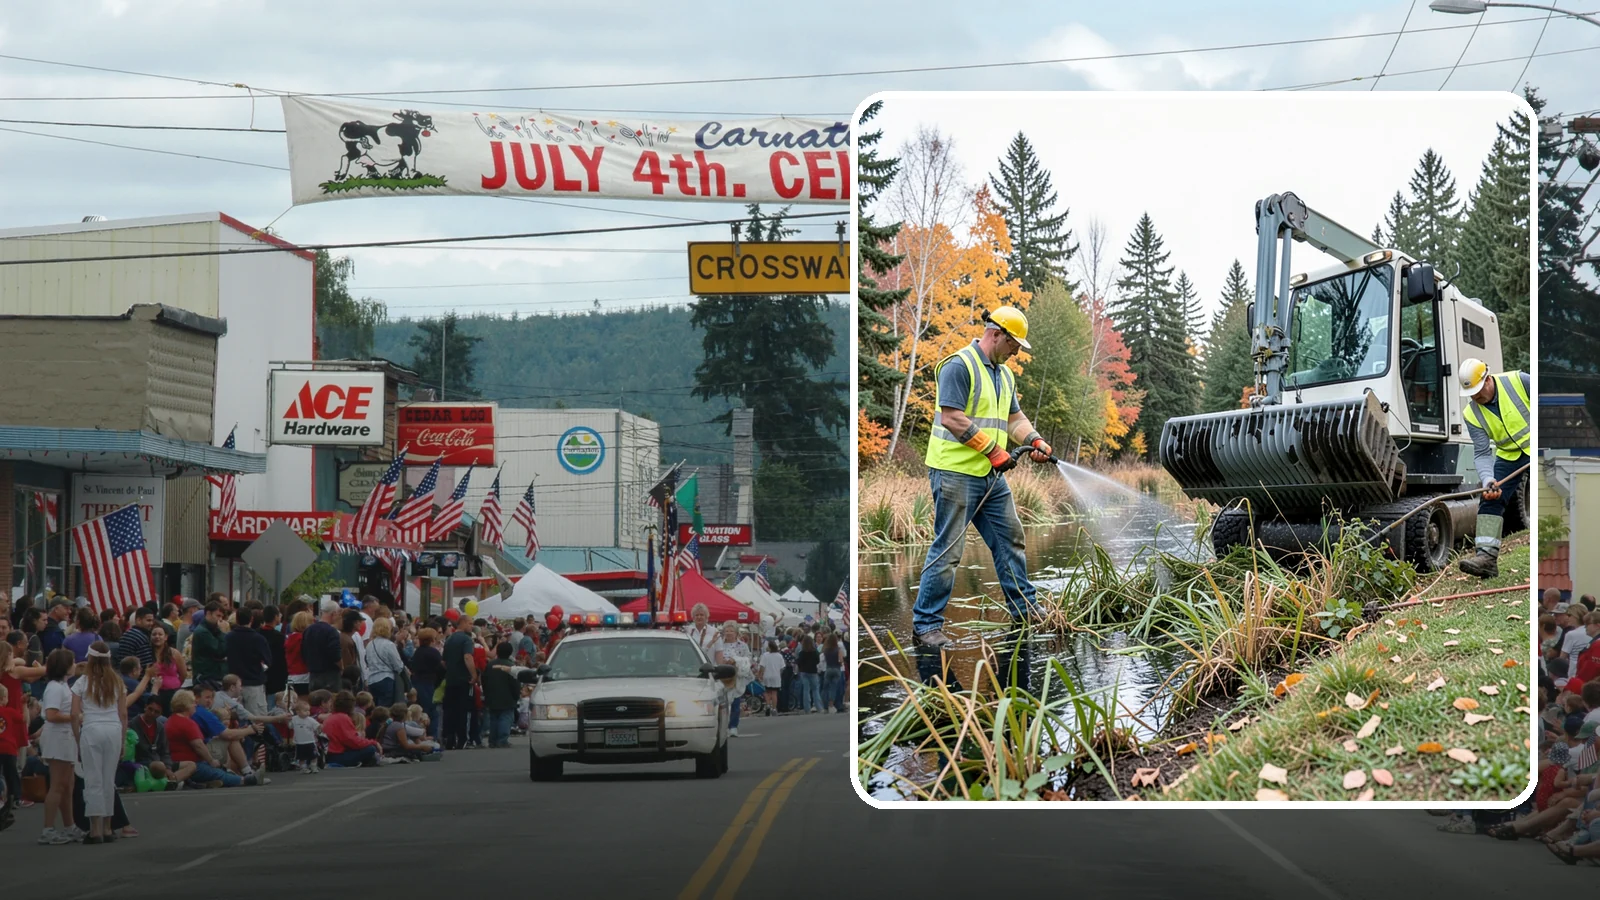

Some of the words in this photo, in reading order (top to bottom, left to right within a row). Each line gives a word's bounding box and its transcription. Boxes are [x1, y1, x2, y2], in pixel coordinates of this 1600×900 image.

[481, 140, 605, 192] JULY
[632, 149, 746, 197] 4th.
[697, 254, 850, 280] CROSSWA
[282, 380, 374, 420] ACE
[405, 409, 452, 422] CEDAR
[283, 421, 371, 436] Hardware
[416, 428, 477, 447] Coca-Cola
[95, 485, 124, 494] Vincent
[126, 486, 136, 494] de
[137, 486, 155, 495] Paul
[688, 526, 741, 535] CRNATION
[699, 535, 730, 543] GLASS
